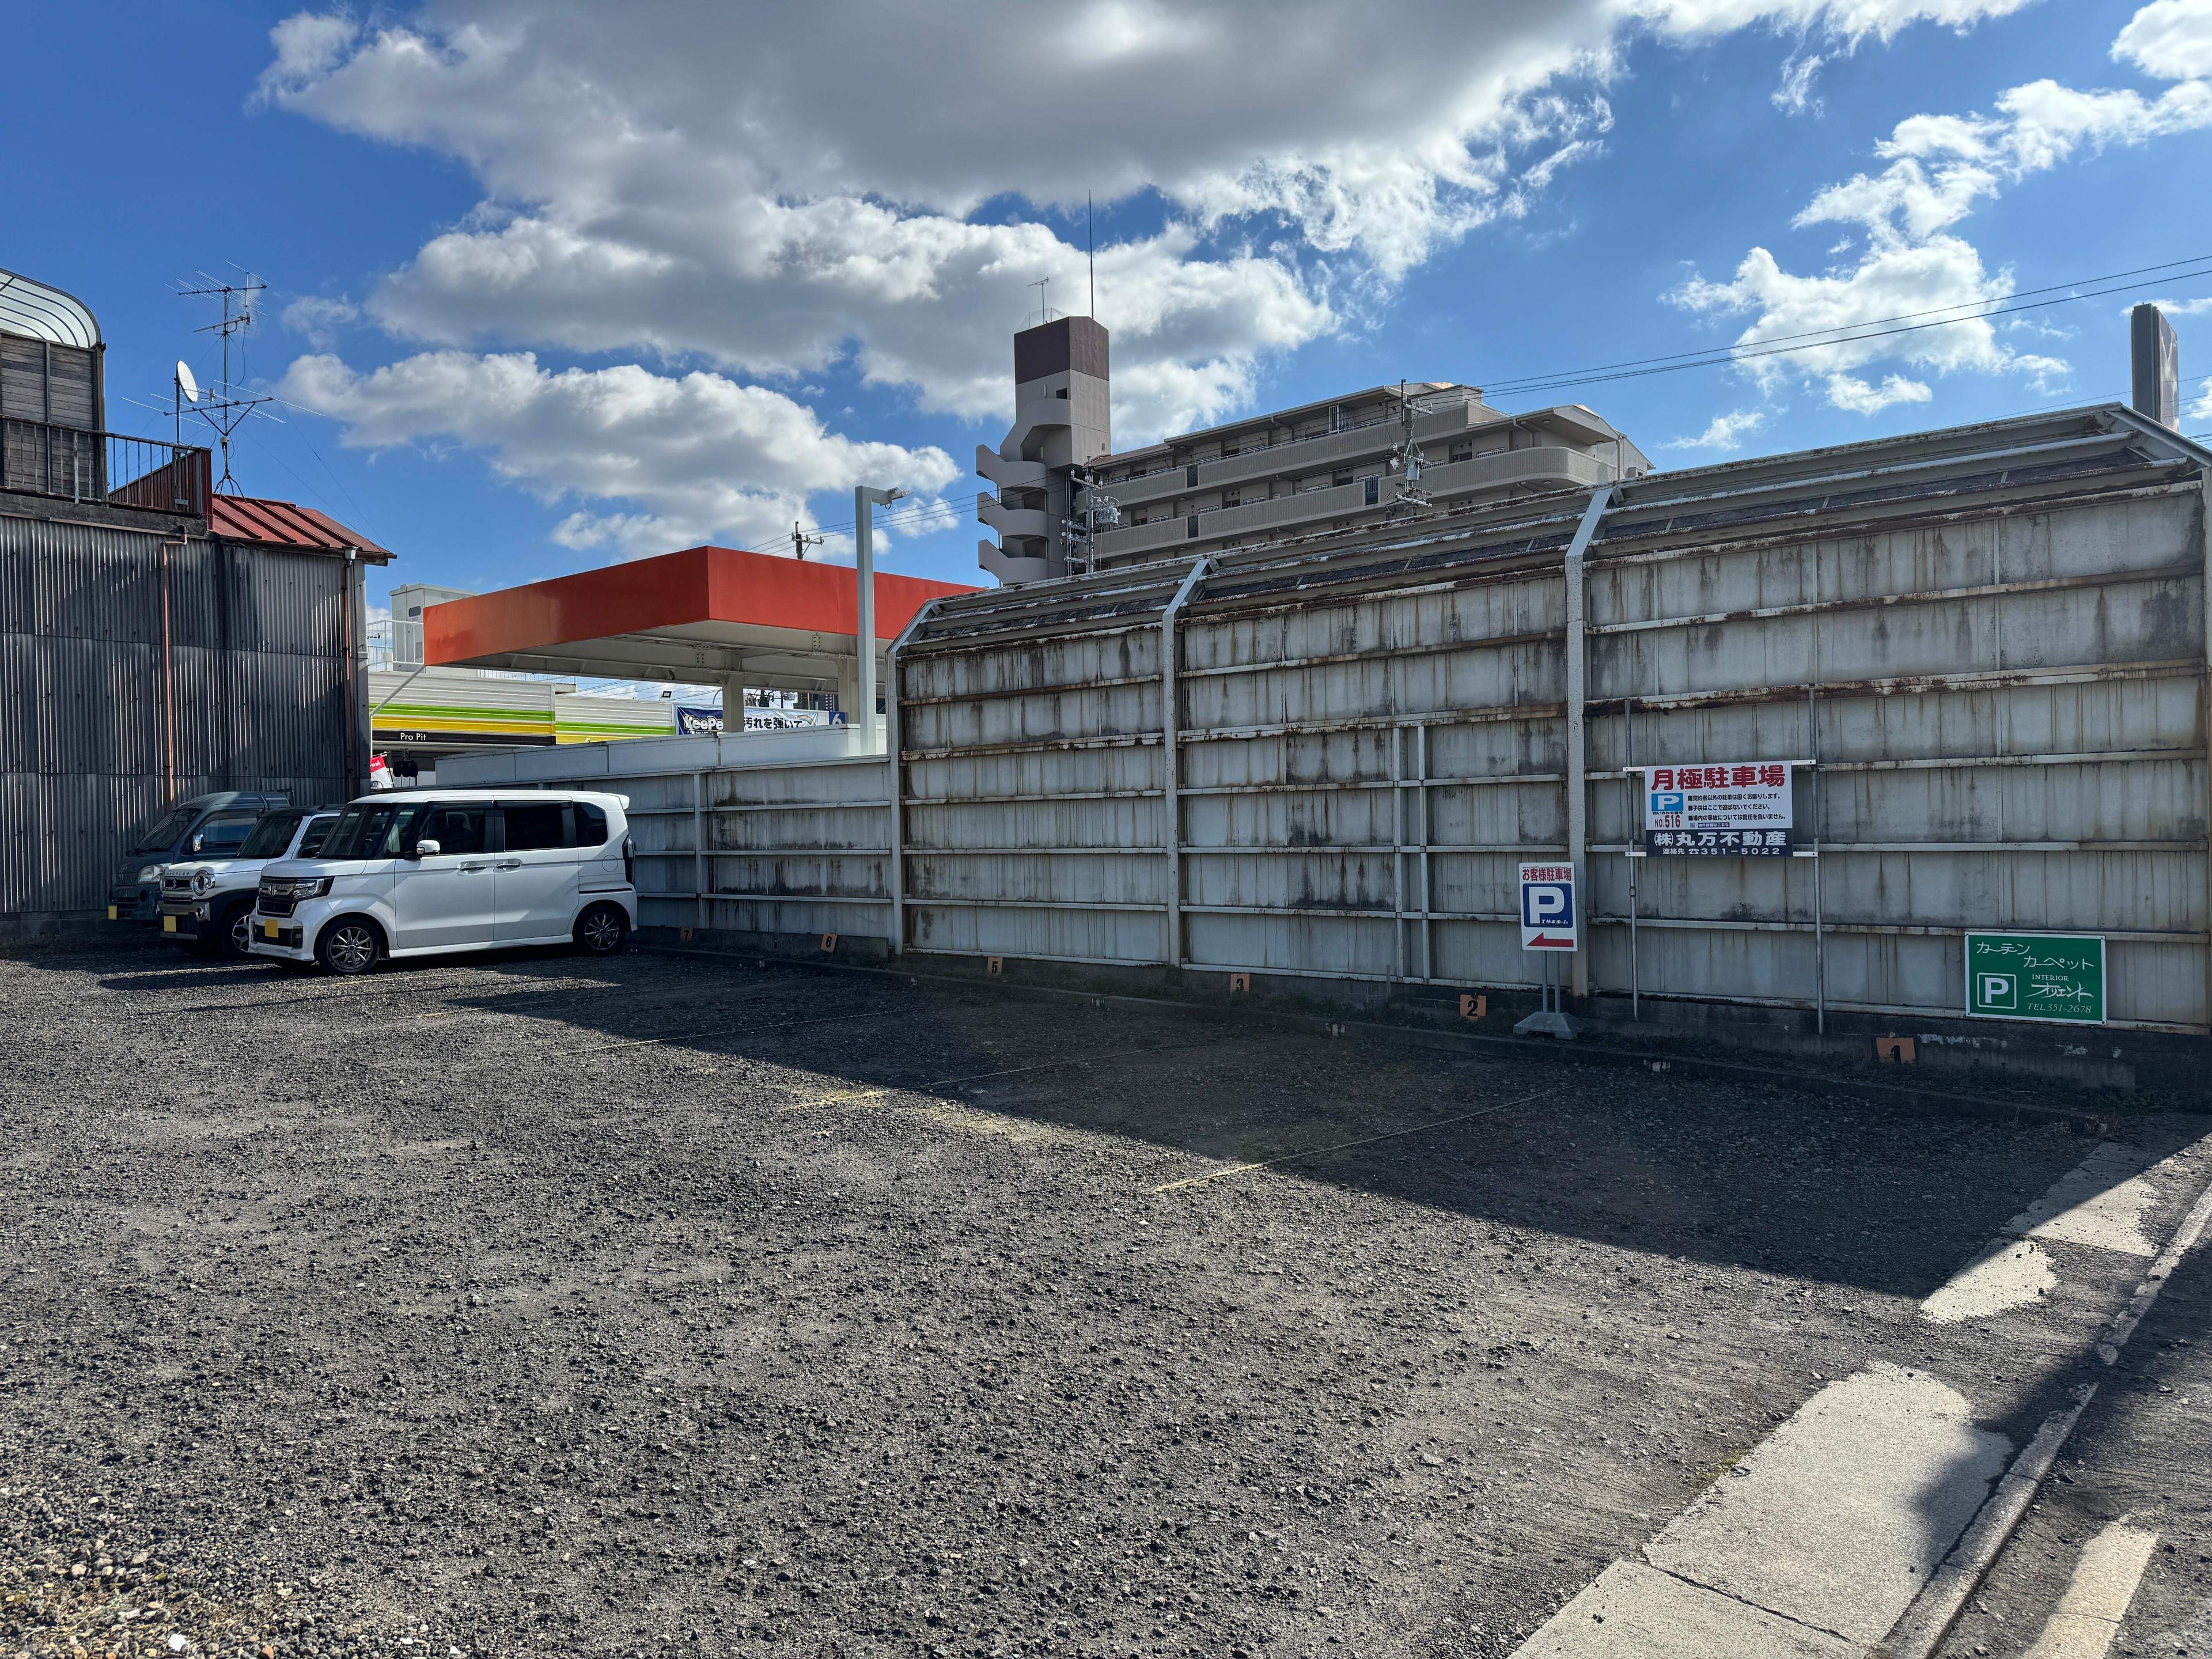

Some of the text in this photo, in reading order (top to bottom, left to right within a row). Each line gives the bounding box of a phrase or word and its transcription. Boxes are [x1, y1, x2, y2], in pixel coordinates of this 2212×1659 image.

[684, 714, 724, 730] KeePe
[743, 717, 803, 730] 汚れを弾いて
[832, 713, 842, 725] 6
[400, 732, 426, 741] Pro Pit
[1651, 764, 1786, 791] 月極駐車場
[1657, 795, 1680, 810] P
[1522, 868, 1572, 882] お客様駐車場
[1528, 887, 1565, 924] P
[683, 930, 690, 941] 7
[825, 935, 833, 948] 6
[1976, 942, 2031, 955] カーテン
[991, 961, 998, 974] 5
[2023, 956, 2094, 970] カーペット
[1236, 978, 1244, 991] 3
[1984, 977, 2009, 1003] P
[1467, 1000, 1478, 1017] 2
[1891, 1045, 1902, 1063] 1
